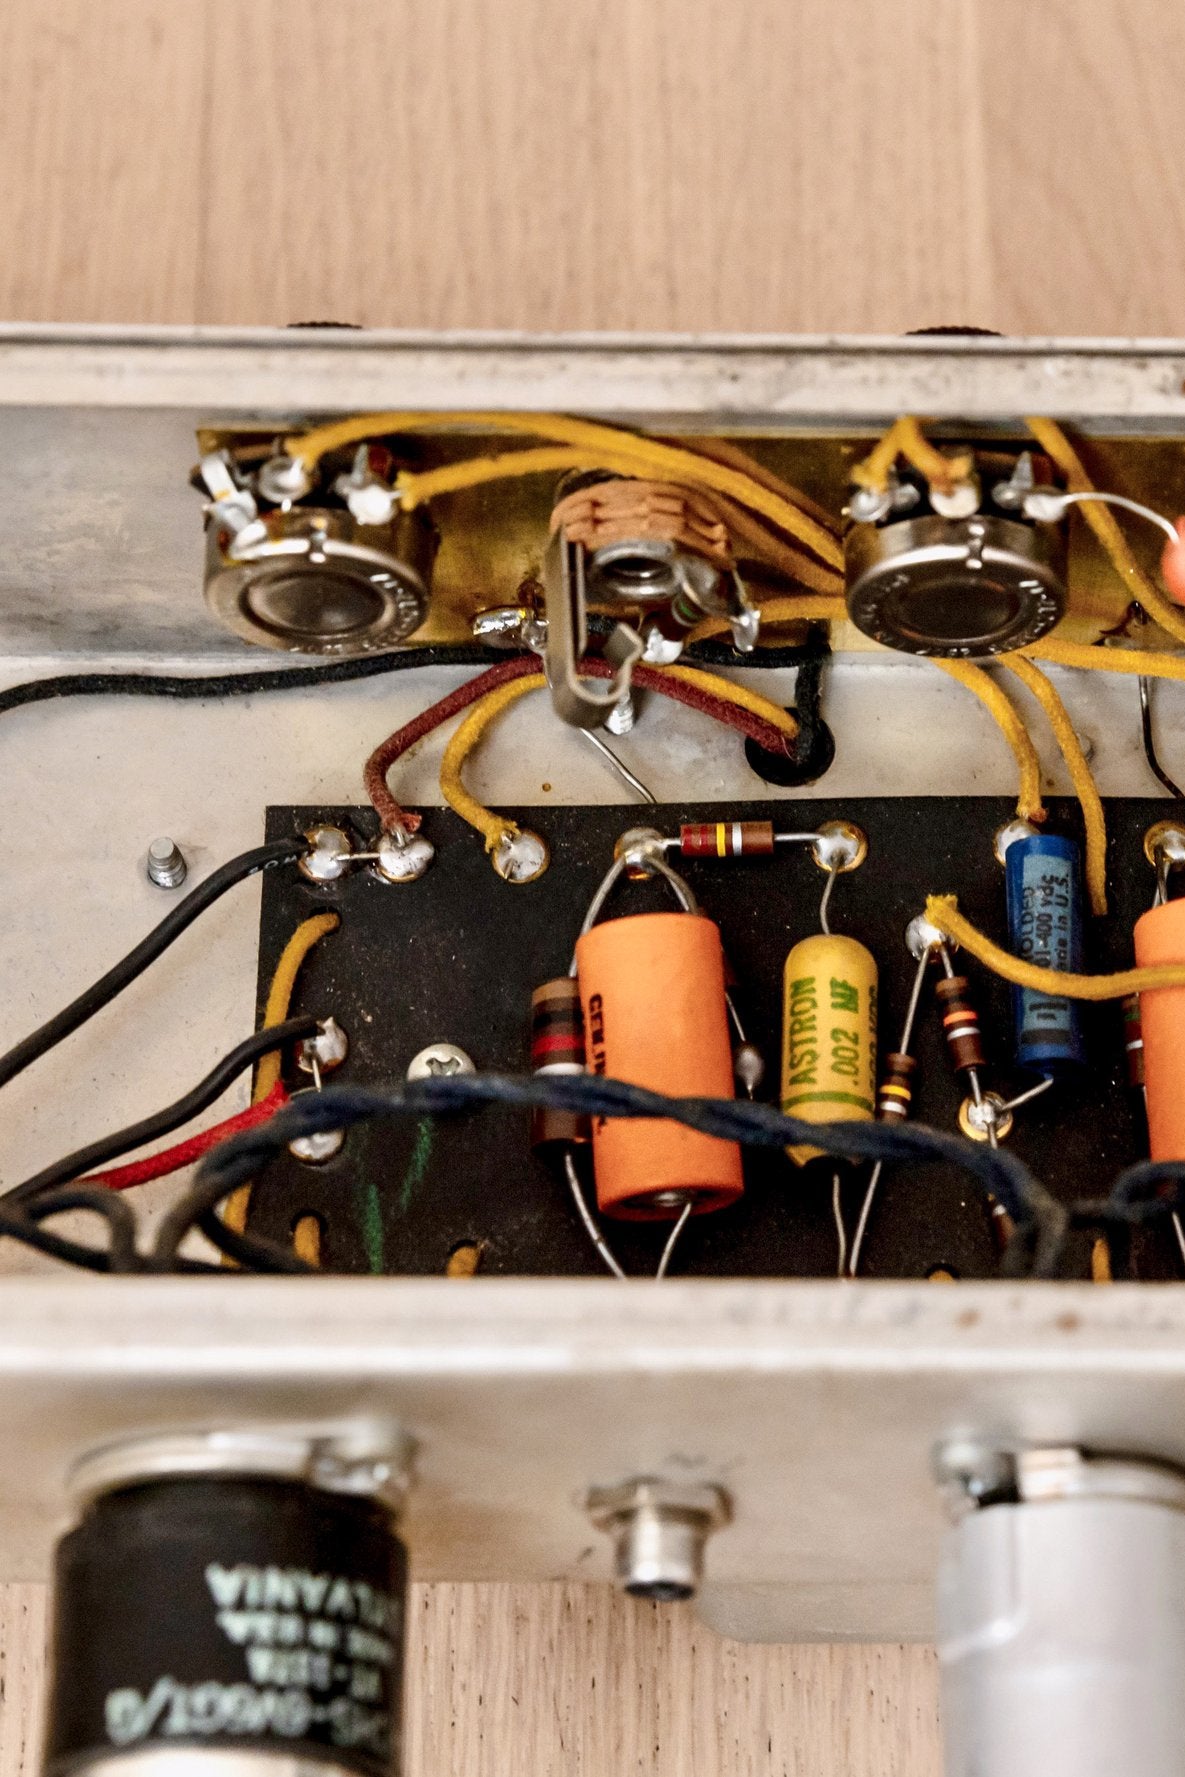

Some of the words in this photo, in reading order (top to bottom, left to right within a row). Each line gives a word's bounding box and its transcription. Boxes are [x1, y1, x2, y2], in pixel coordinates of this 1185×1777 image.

[1054, 939, 1068, 971] ade
[789, 977, 819, 1085] ASTRON
[830, 1028, 858, 1086] .002
